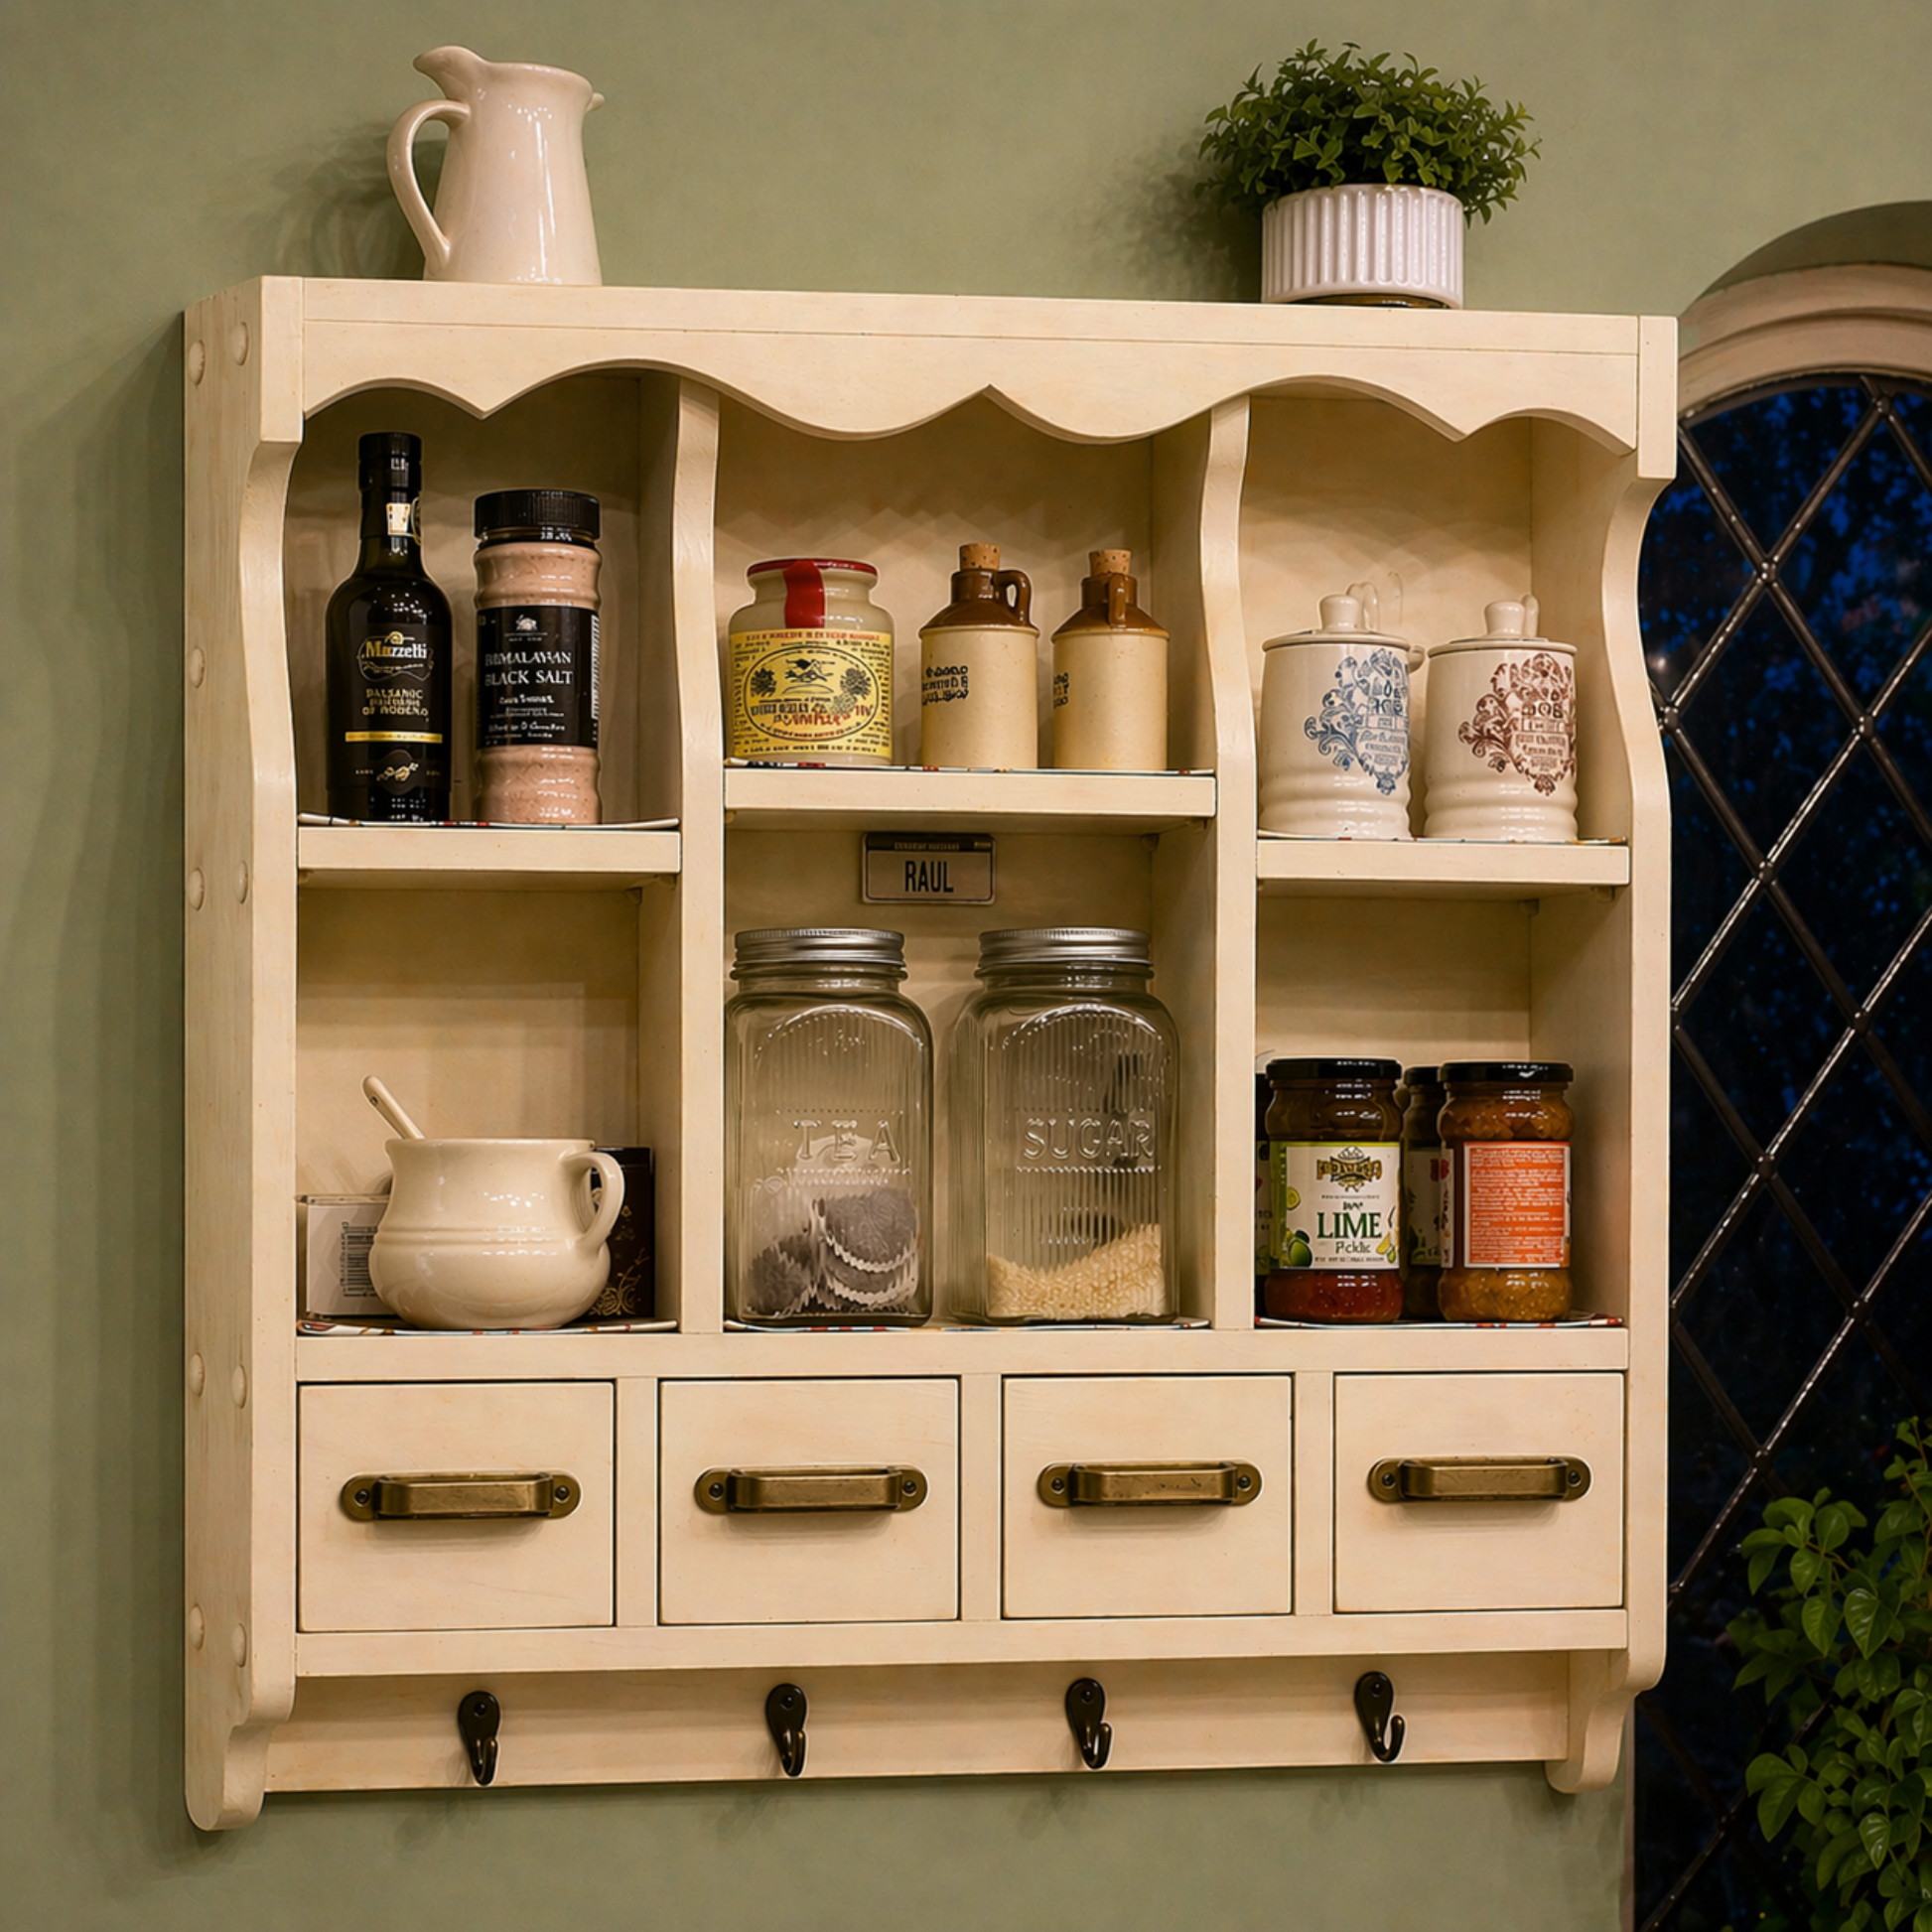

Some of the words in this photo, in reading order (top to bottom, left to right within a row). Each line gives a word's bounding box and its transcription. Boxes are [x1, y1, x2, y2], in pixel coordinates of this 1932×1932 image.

[484, 670, 530, 686] BLACK
[535, 670, 573, 685] SALT
[904, 860, 954, 893] RAUL
[793, 1118, 900, 1164] TEA
[1023, 1117, 1155, 1161] SUGAR
[1316, 1211, 1383, 1239] LIME
